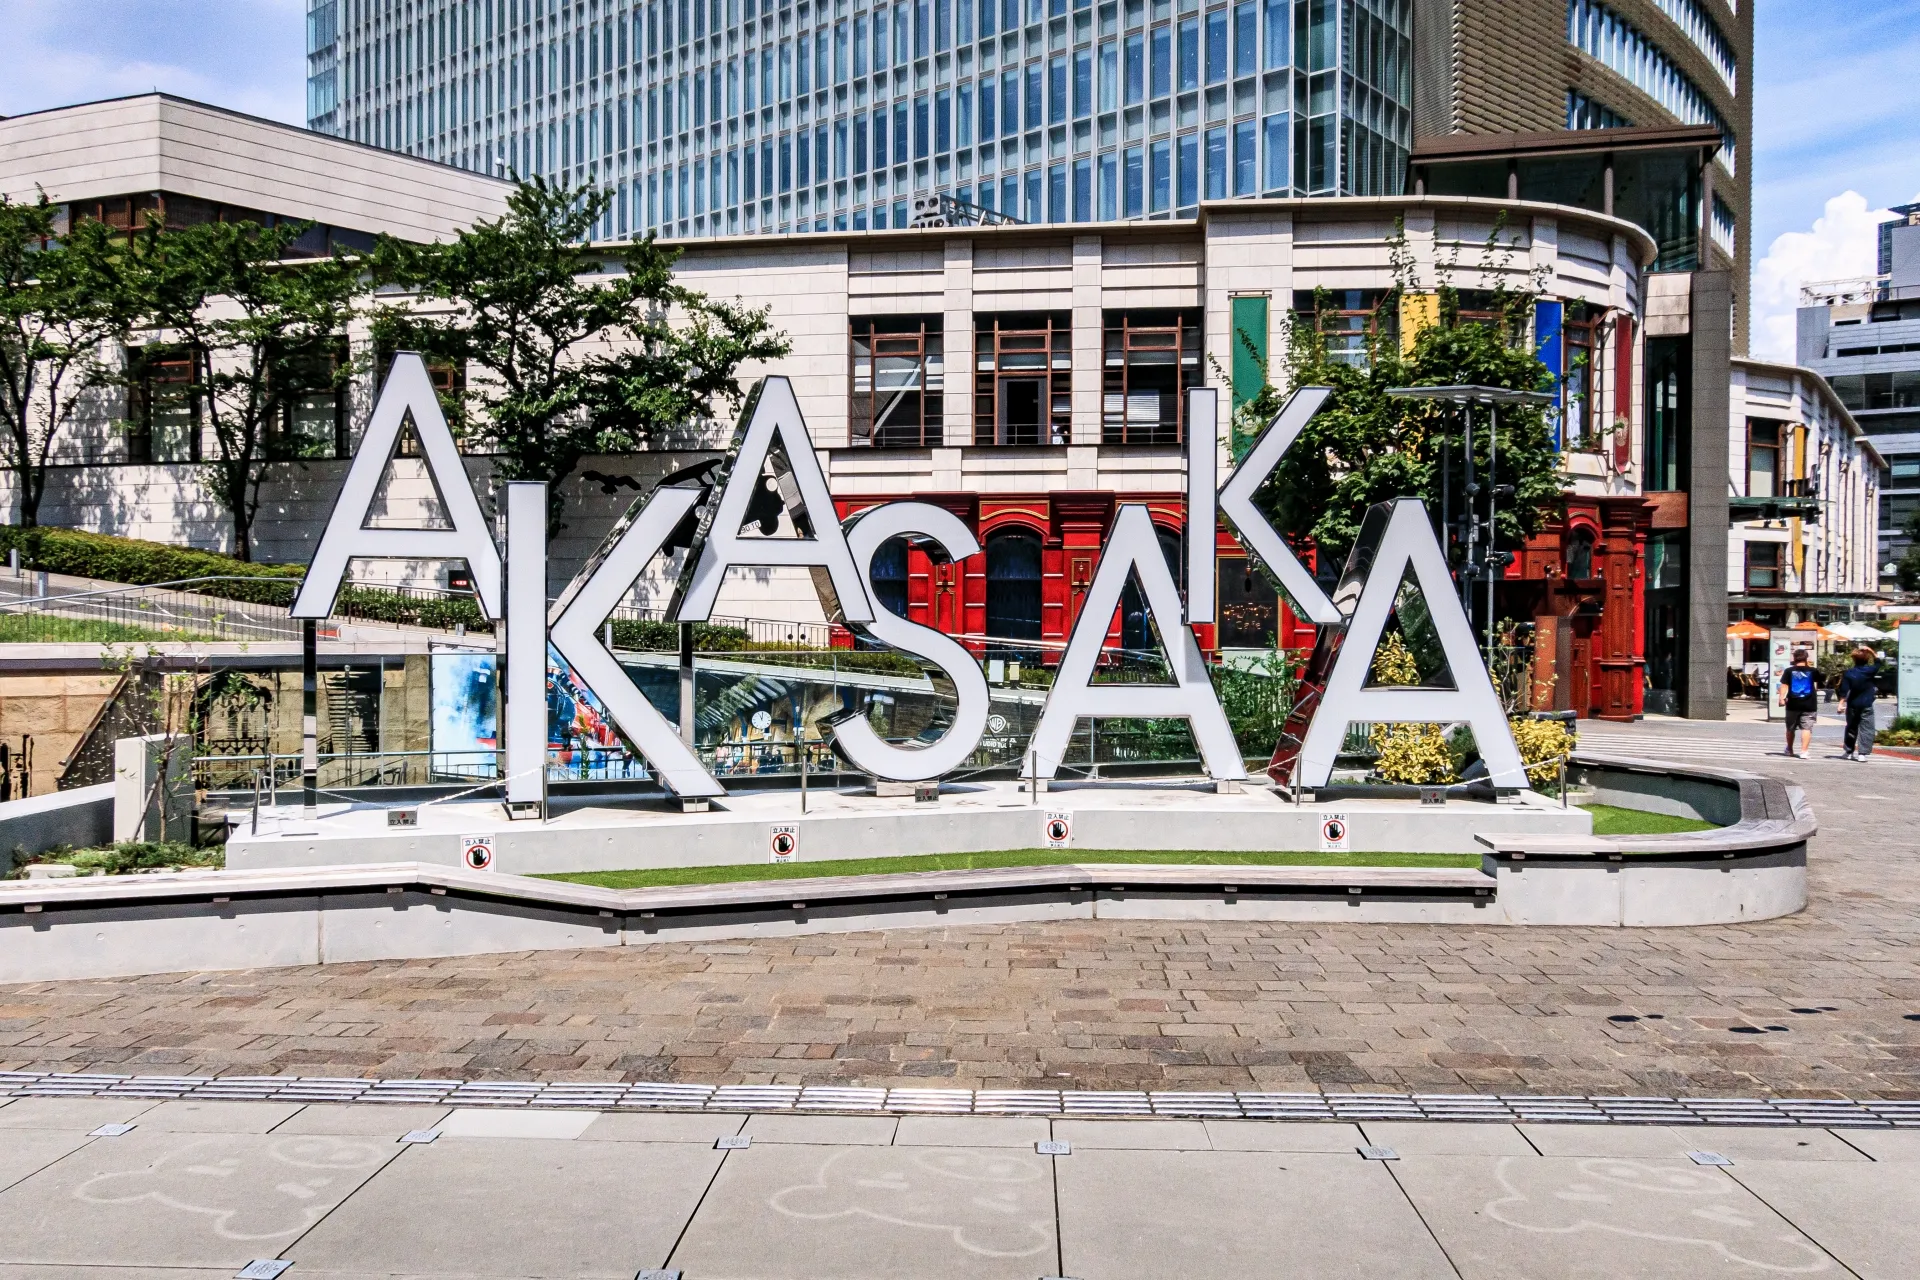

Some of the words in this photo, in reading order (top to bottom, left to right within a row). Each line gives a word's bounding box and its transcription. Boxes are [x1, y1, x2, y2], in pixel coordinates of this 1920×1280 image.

[291, 352, 1530, 804] AKASAKA
[1047, 813, 1070, 821] 立入禁止
[389, 818, 417, 826] 立入禁止
[772, 826, 796, 834] 立入禁止
[464, 838, 492, 847] 立入禁止
